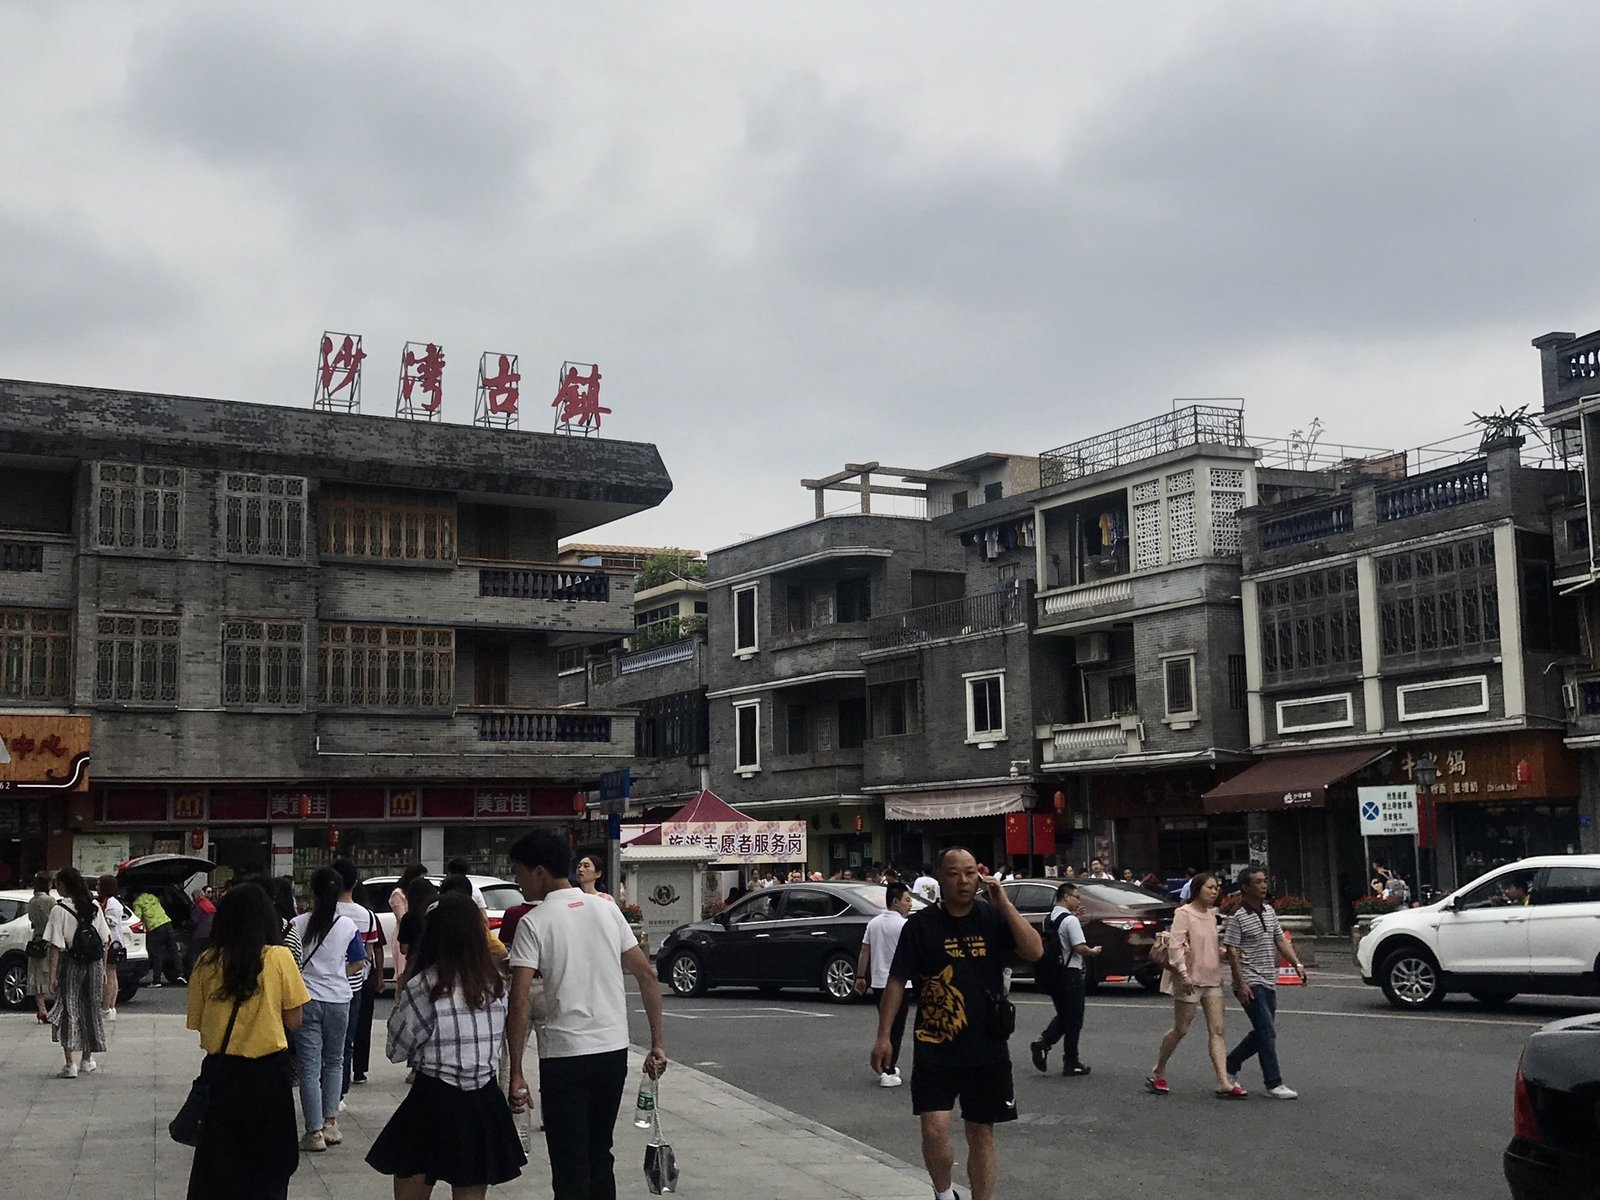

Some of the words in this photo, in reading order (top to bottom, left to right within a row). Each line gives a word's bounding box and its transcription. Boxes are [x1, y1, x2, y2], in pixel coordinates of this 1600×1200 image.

[478, 793, 527, 813] 美宜佳
[946, 948, 986, 958] VICOR
